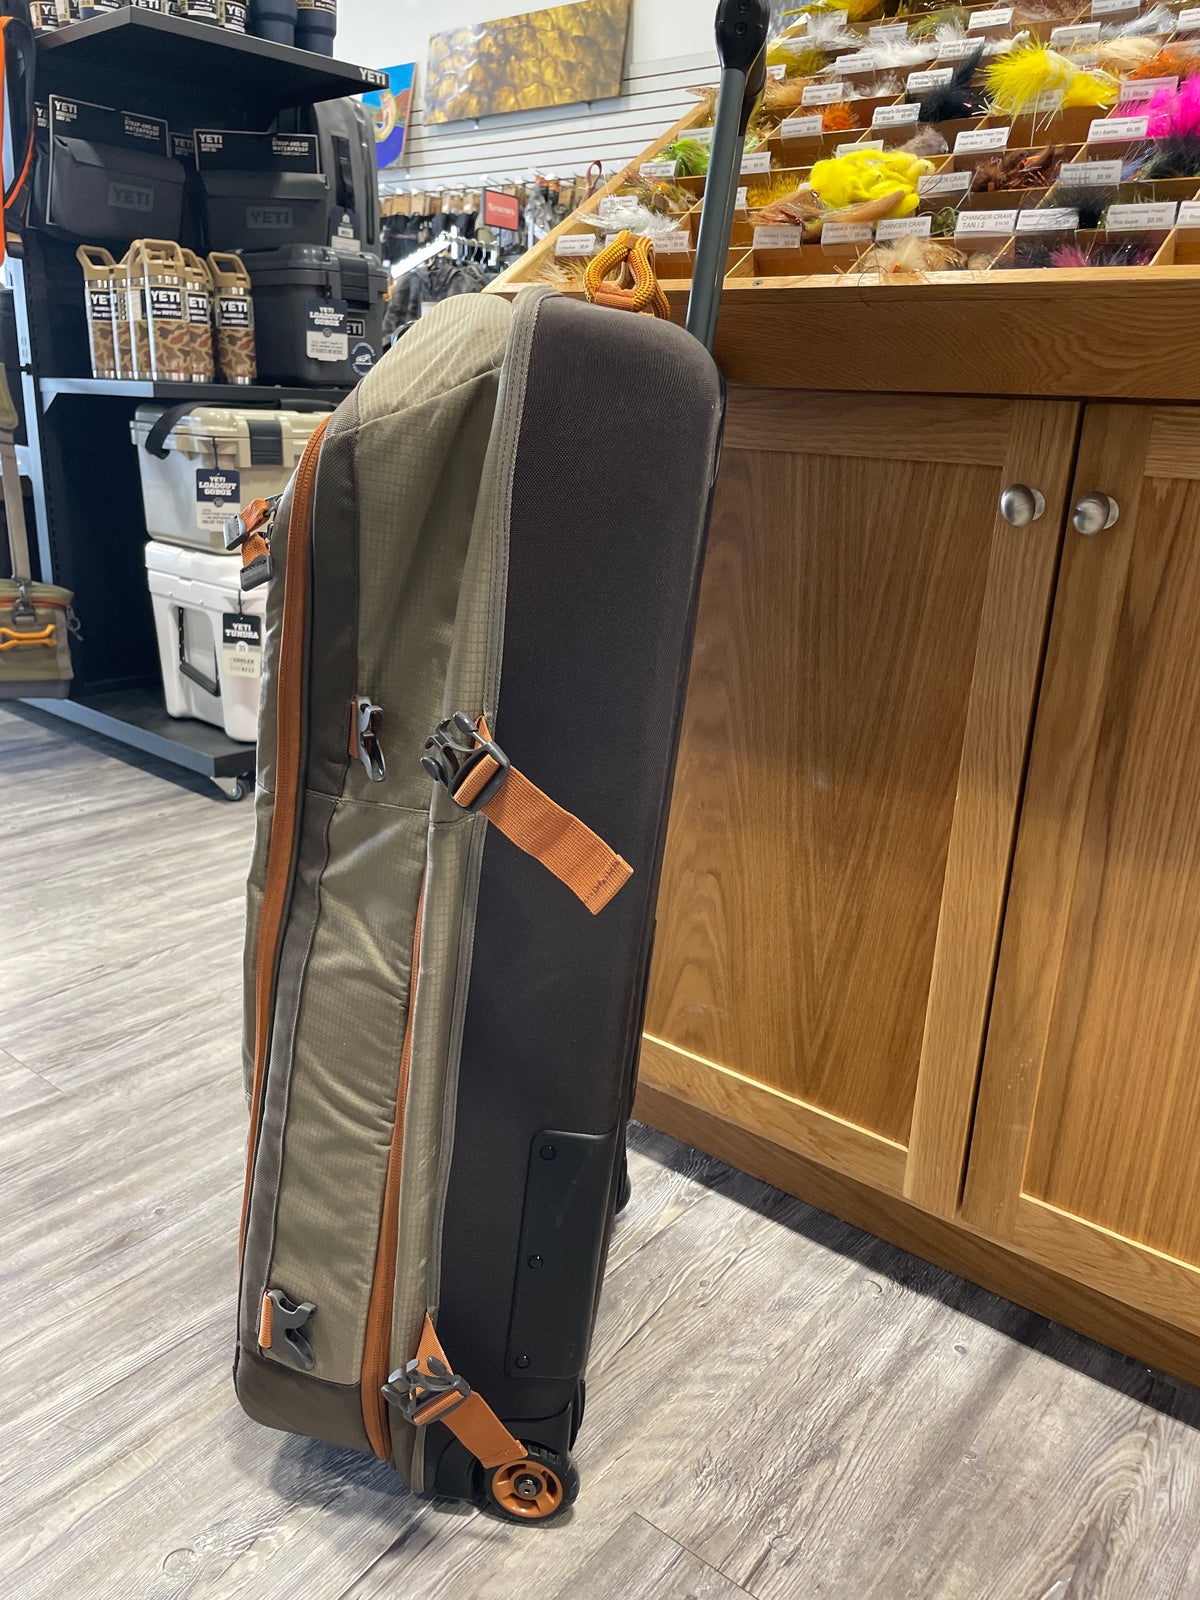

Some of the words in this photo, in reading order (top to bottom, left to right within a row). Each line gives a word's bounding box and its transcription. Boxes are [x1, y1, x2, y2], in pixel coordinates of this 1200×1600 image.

[359, 67, 387, 86] YETI
[54, 100, 78, 114] YETI
[199, 134, 223, 144] YETI
[113, 186, 150, 206] YETI
[249, 210, 290, 225] YETI
[962, 213, 993, 222] CHANGER
[993, 212, 1014, 220] CRAW
[879, 221, 908, 230] CHANGER
[151, 290, 181, 303] YETI
[188, 296, 207, 309] ETI
[220, 300, 248, 313] YETI
[309, 311, 345, 321] LOADOUT
[209, 475, 226, 483] YETI
[198, 481, 237, 490] LOADOUT
[232, 622, 252, 631] YETI
[224, 628, 260, 640] TUNDRA
